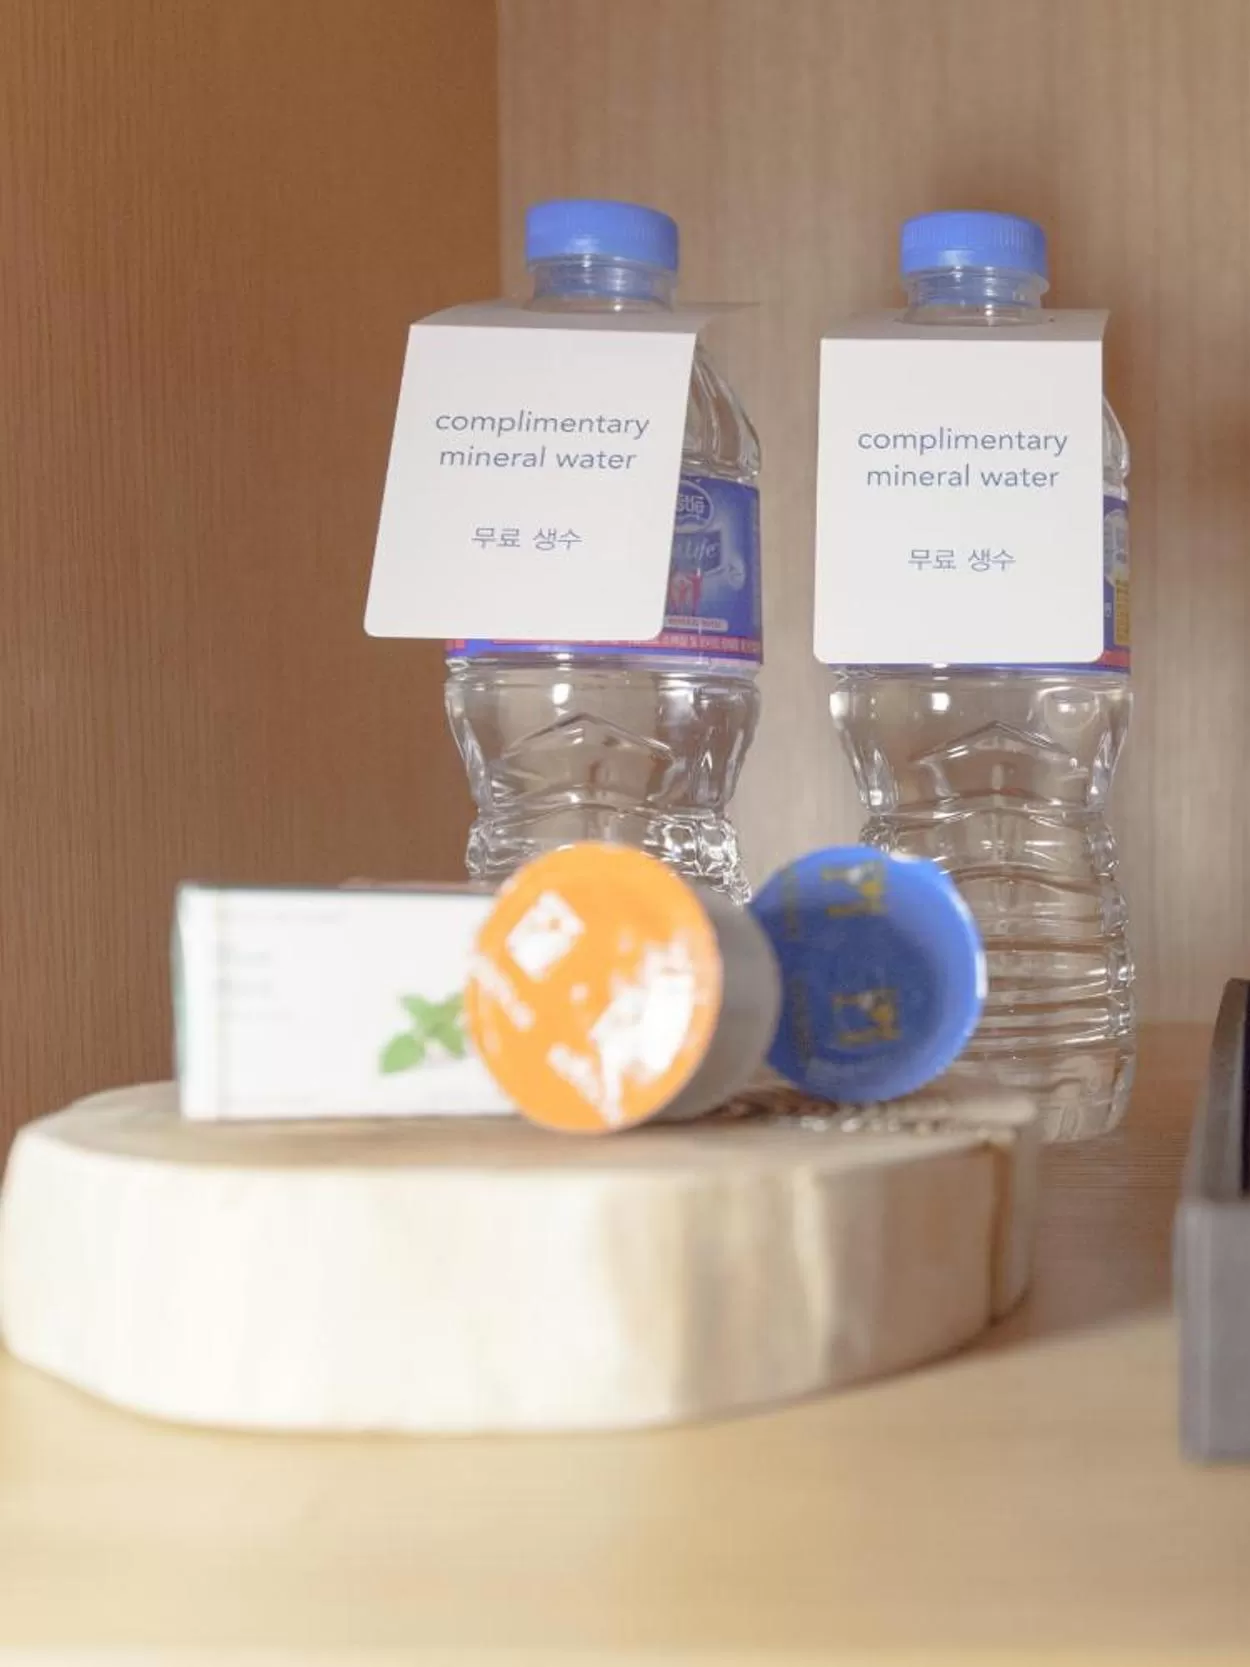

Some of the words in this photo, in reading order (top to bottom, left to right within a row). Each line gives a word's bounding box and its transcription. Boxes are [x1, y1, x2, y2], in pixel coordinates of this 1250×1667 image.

[435, 409, 650, 440] complimentary
[857, 426, 1068, 458] complimentary
[439, 445, 546, 469] mineral
[555, 449, 637, 471] water
[867, 463, 970, 488] mineral
[980, 466, 1060, 488] water
[471, 527, 521, 549] 무료
[532, 526, 583, 552] 생수
[908, 549, 957, 571] 무료
[967, 548, 1015, 573] 생수
